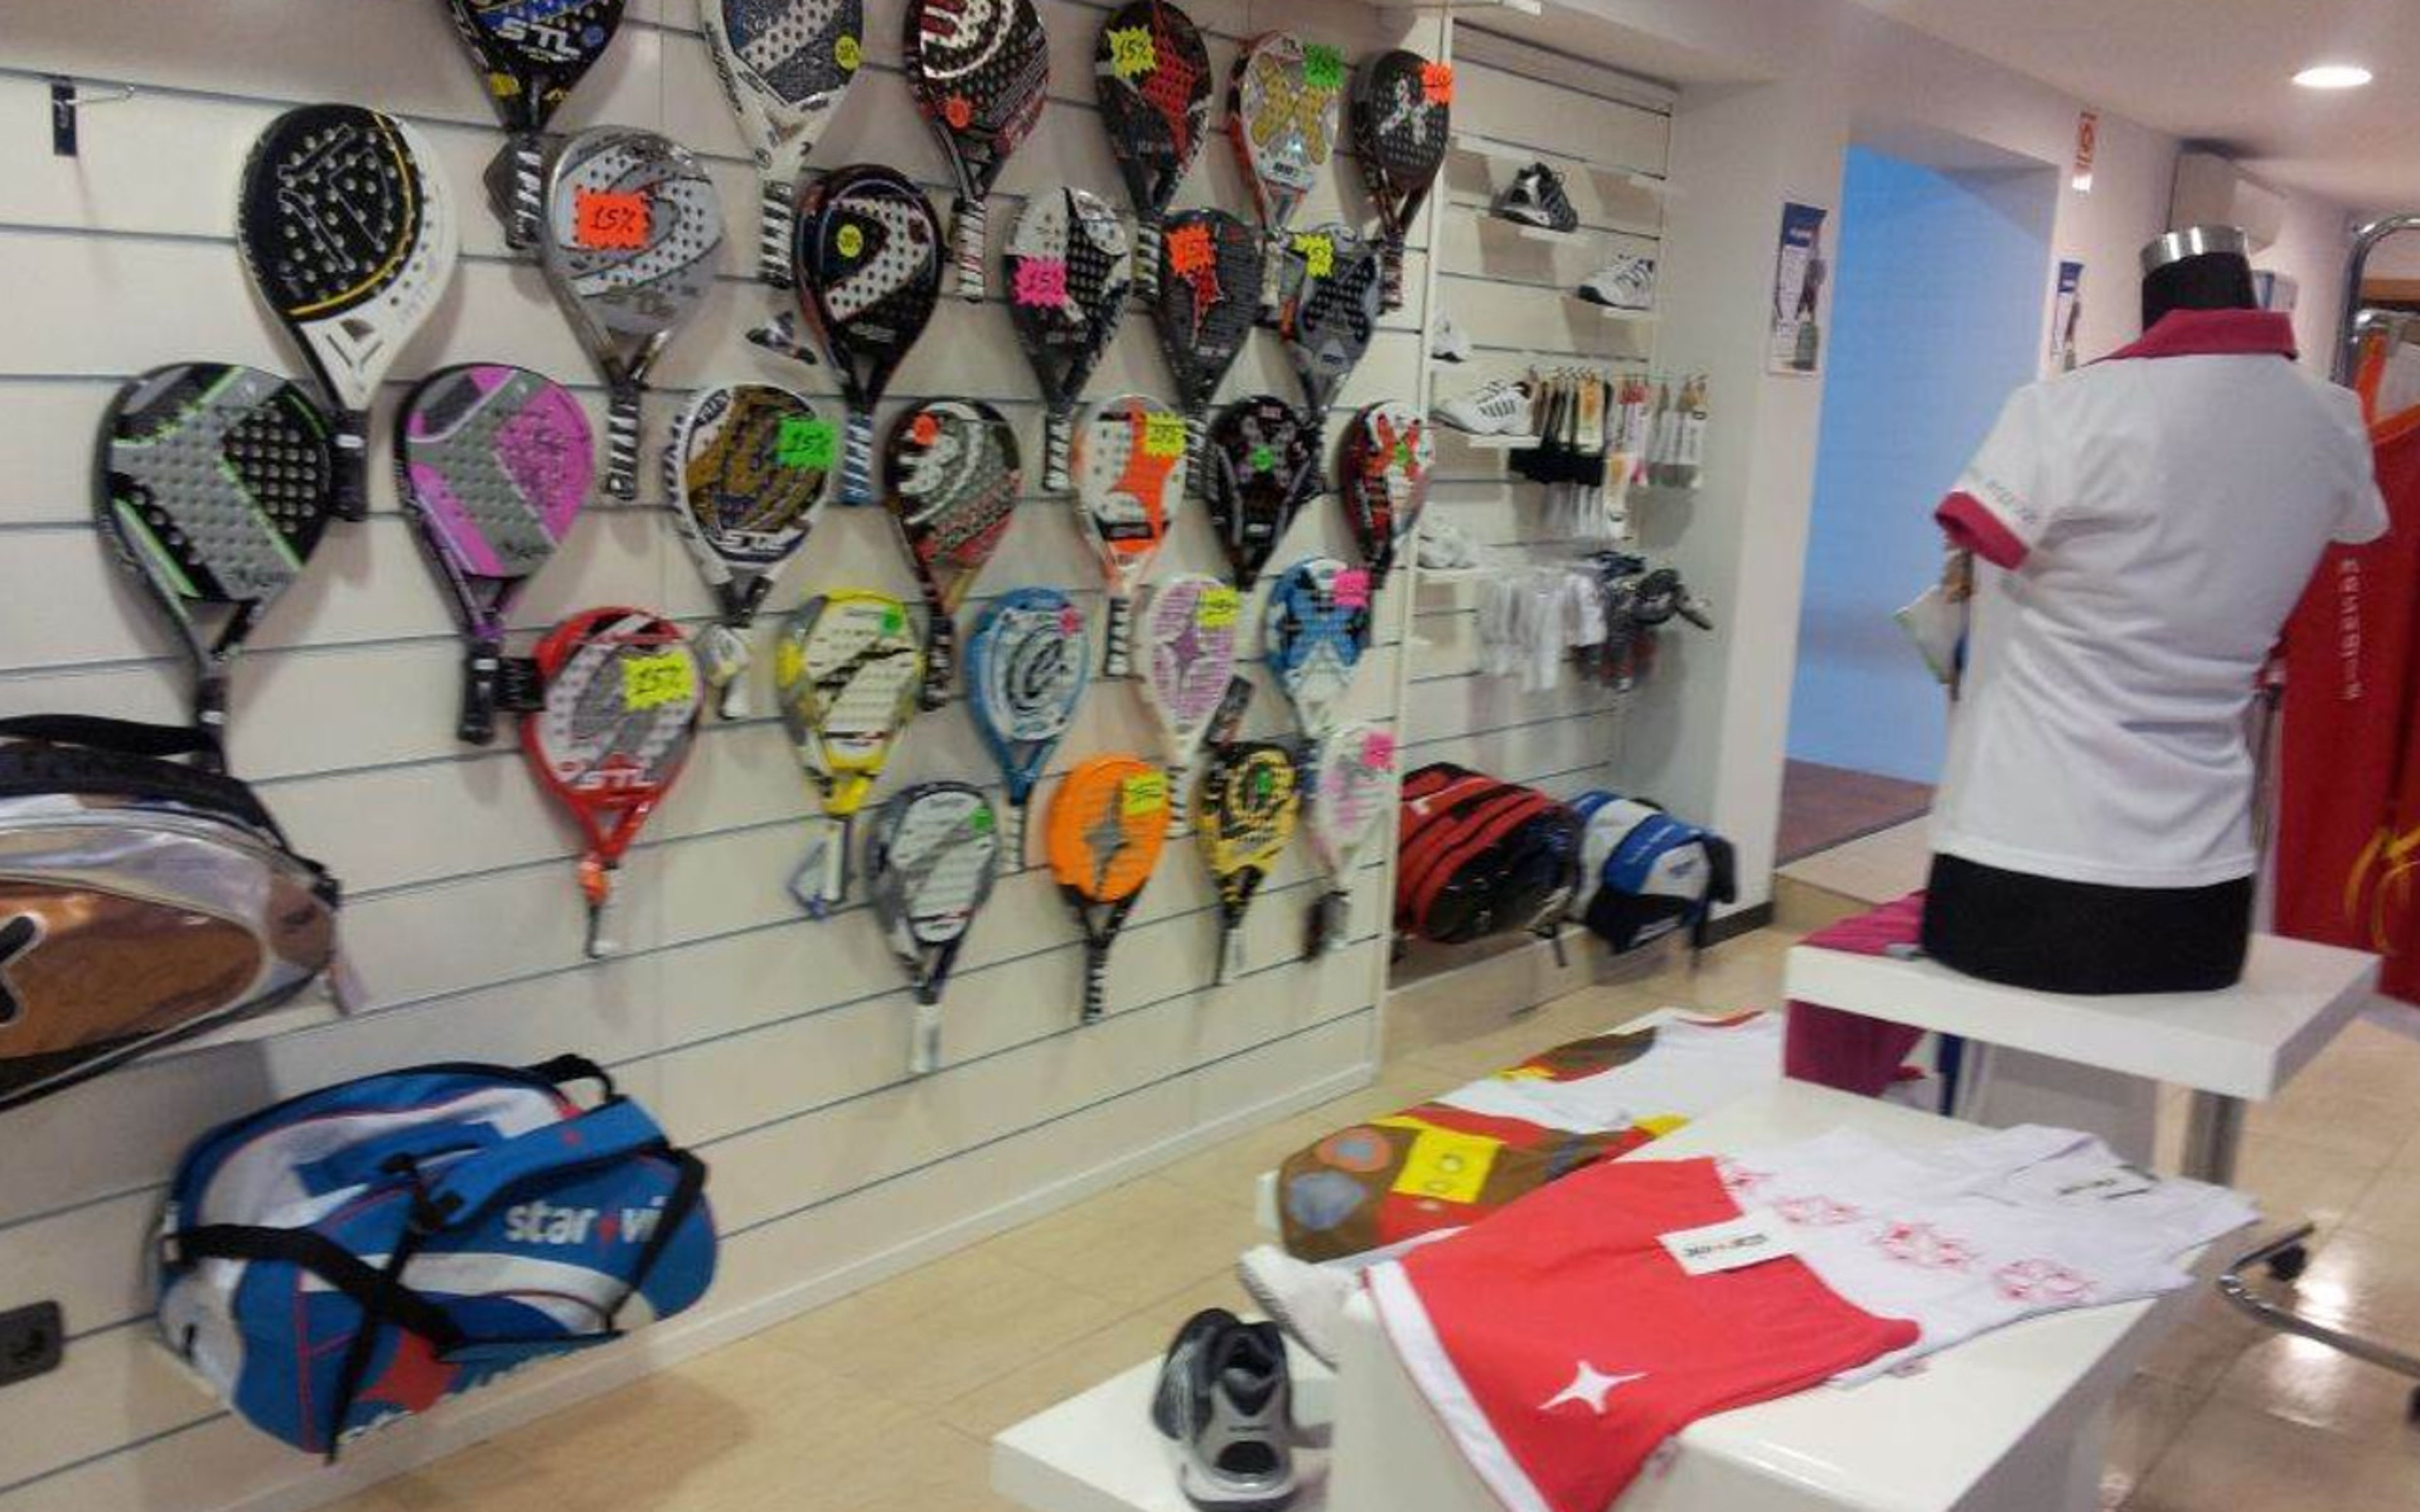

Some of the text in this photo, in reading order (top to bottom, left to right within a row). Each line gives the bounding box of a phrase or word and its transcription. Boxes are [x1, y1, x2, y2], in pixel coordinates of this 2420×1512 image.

[496, 16, 581, 56] STL
[590, 205, 637, 233] 15%
[784, 431, 831, 457] 15%
